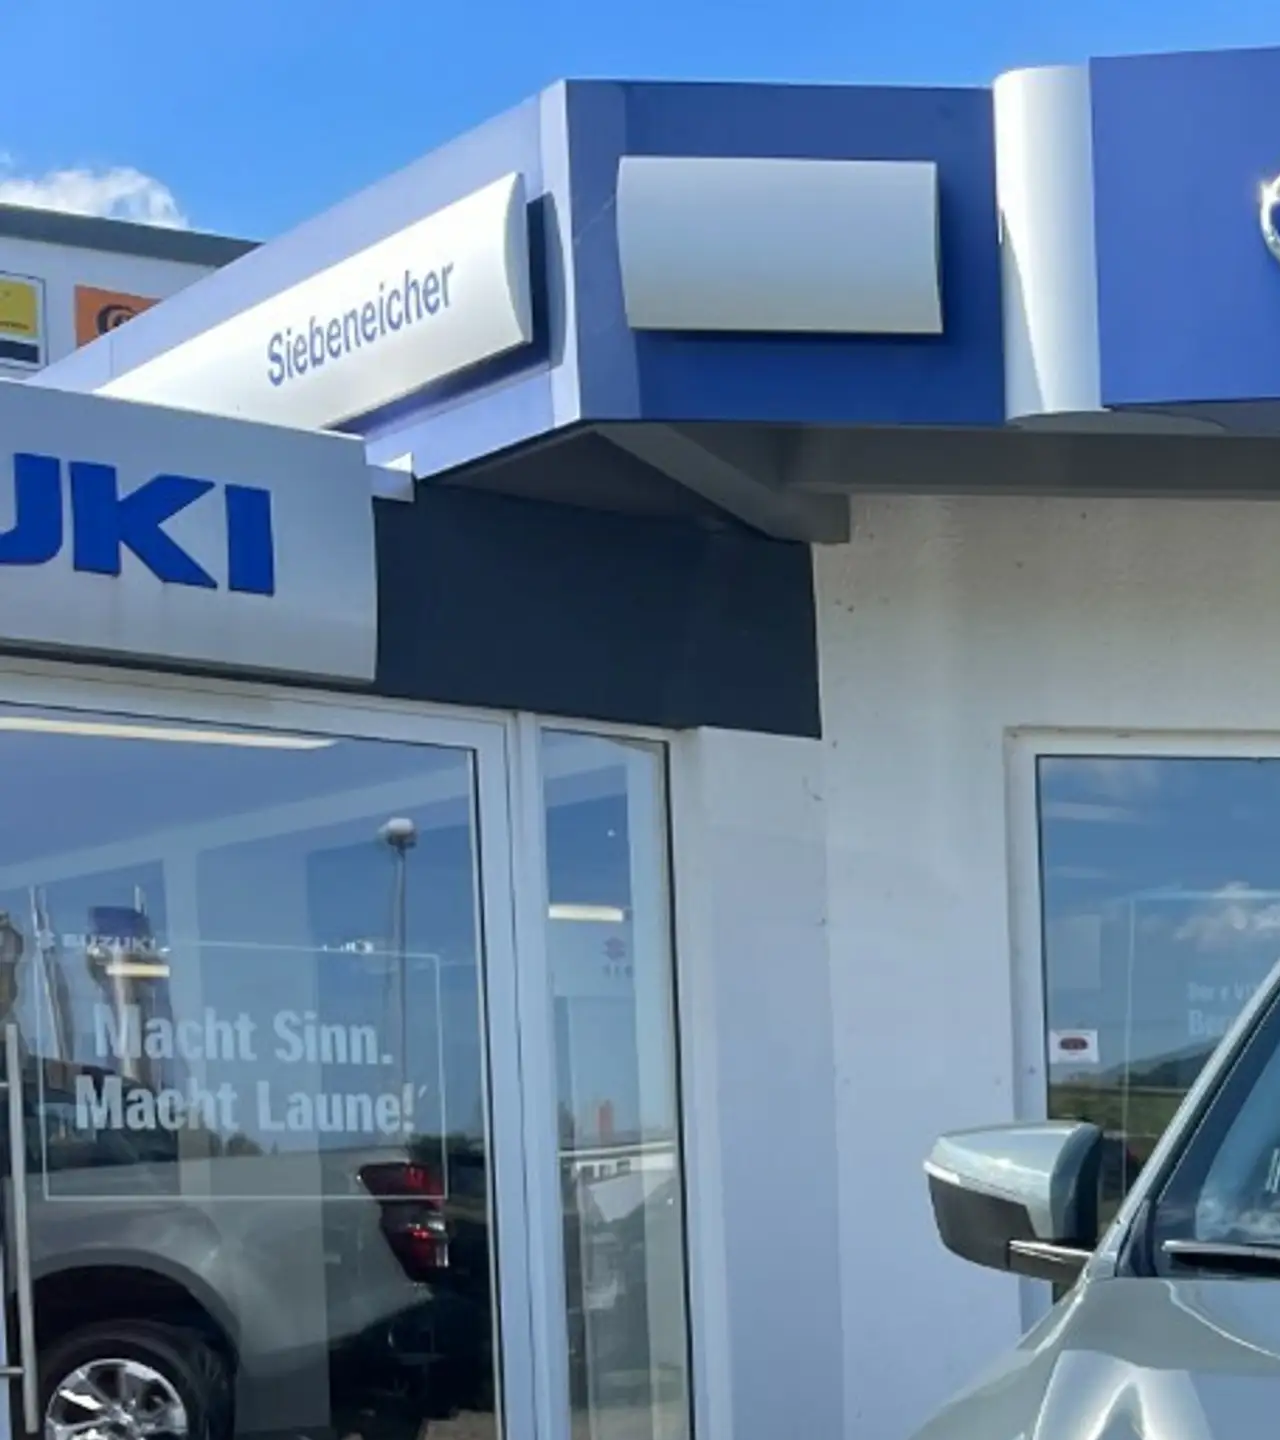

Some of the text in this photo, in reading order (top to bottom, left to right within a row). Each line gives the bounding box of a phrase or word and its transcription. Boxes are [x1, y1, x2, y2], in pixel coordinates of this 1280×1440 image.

[266, 260, 456, 387] Siebeneicher
[94, 1005, 394, 1064] Macht Sinn.
[75, 1075, 238, 1129] Macht
